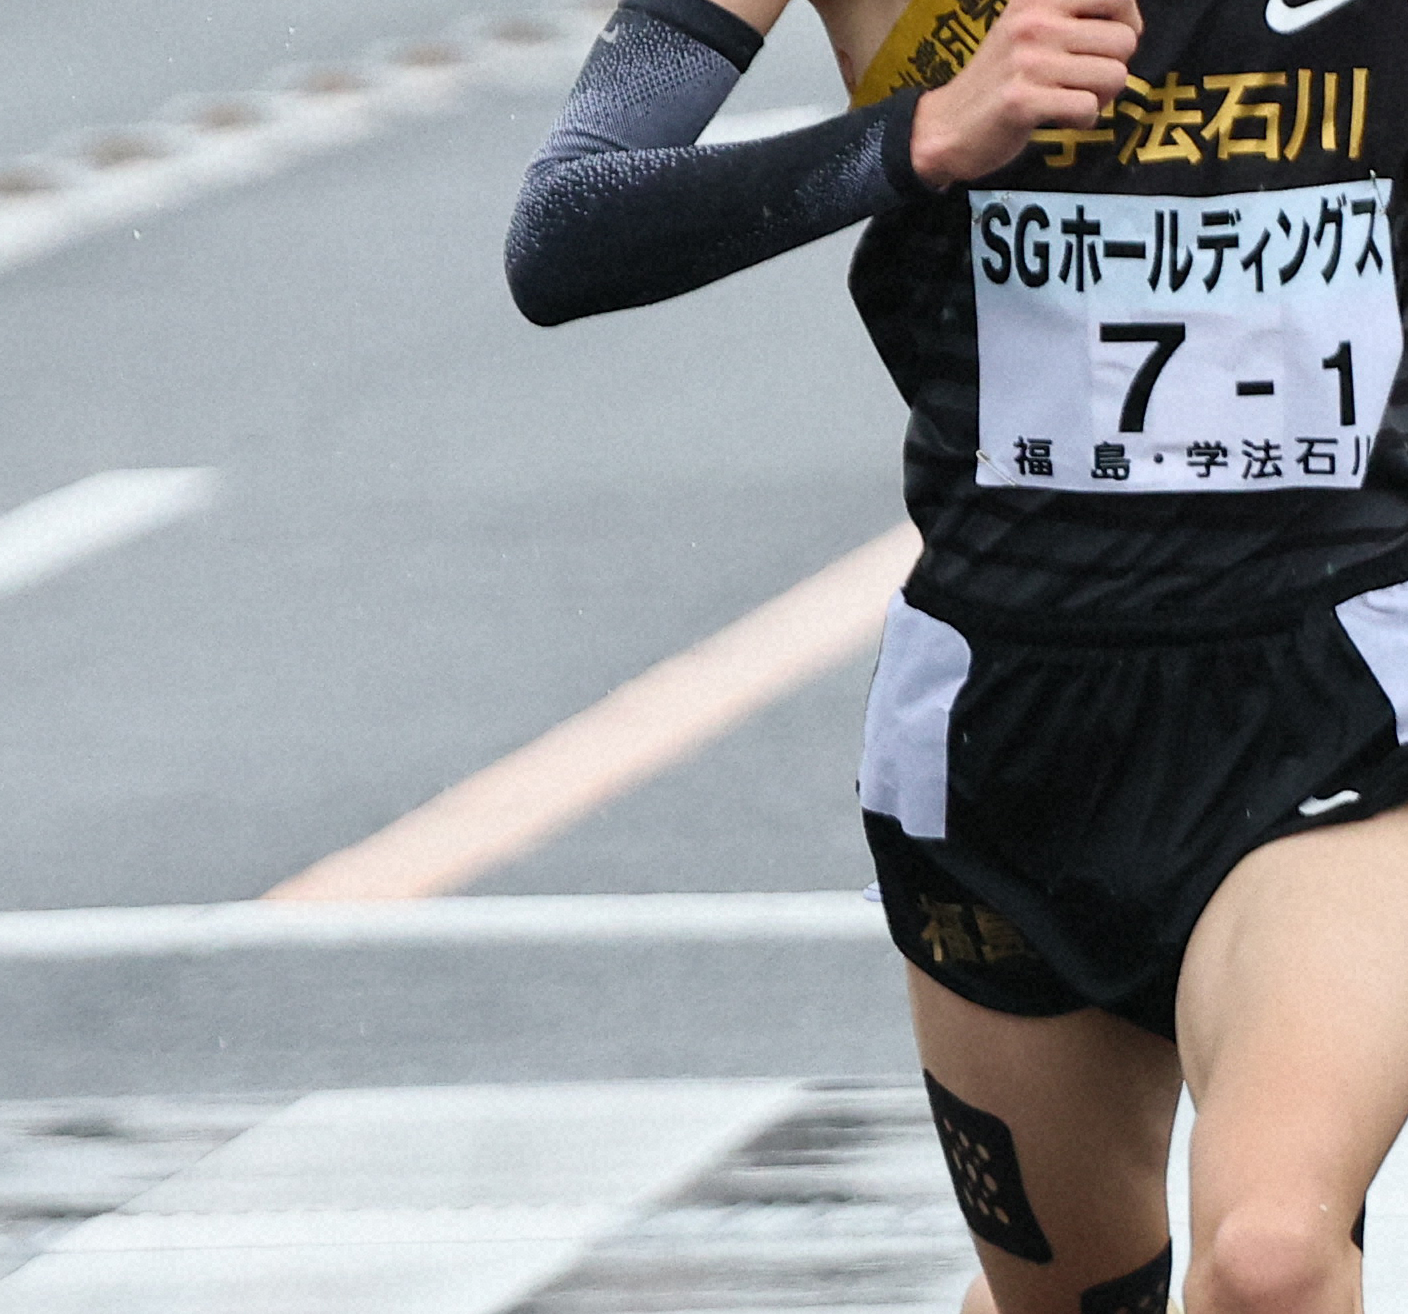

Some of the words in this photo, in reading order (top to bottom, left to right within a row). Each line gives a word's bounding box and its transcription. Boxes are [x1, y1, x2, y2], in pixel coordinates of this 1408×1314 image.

[980, 192, 1384, 294] SGホールディングス
